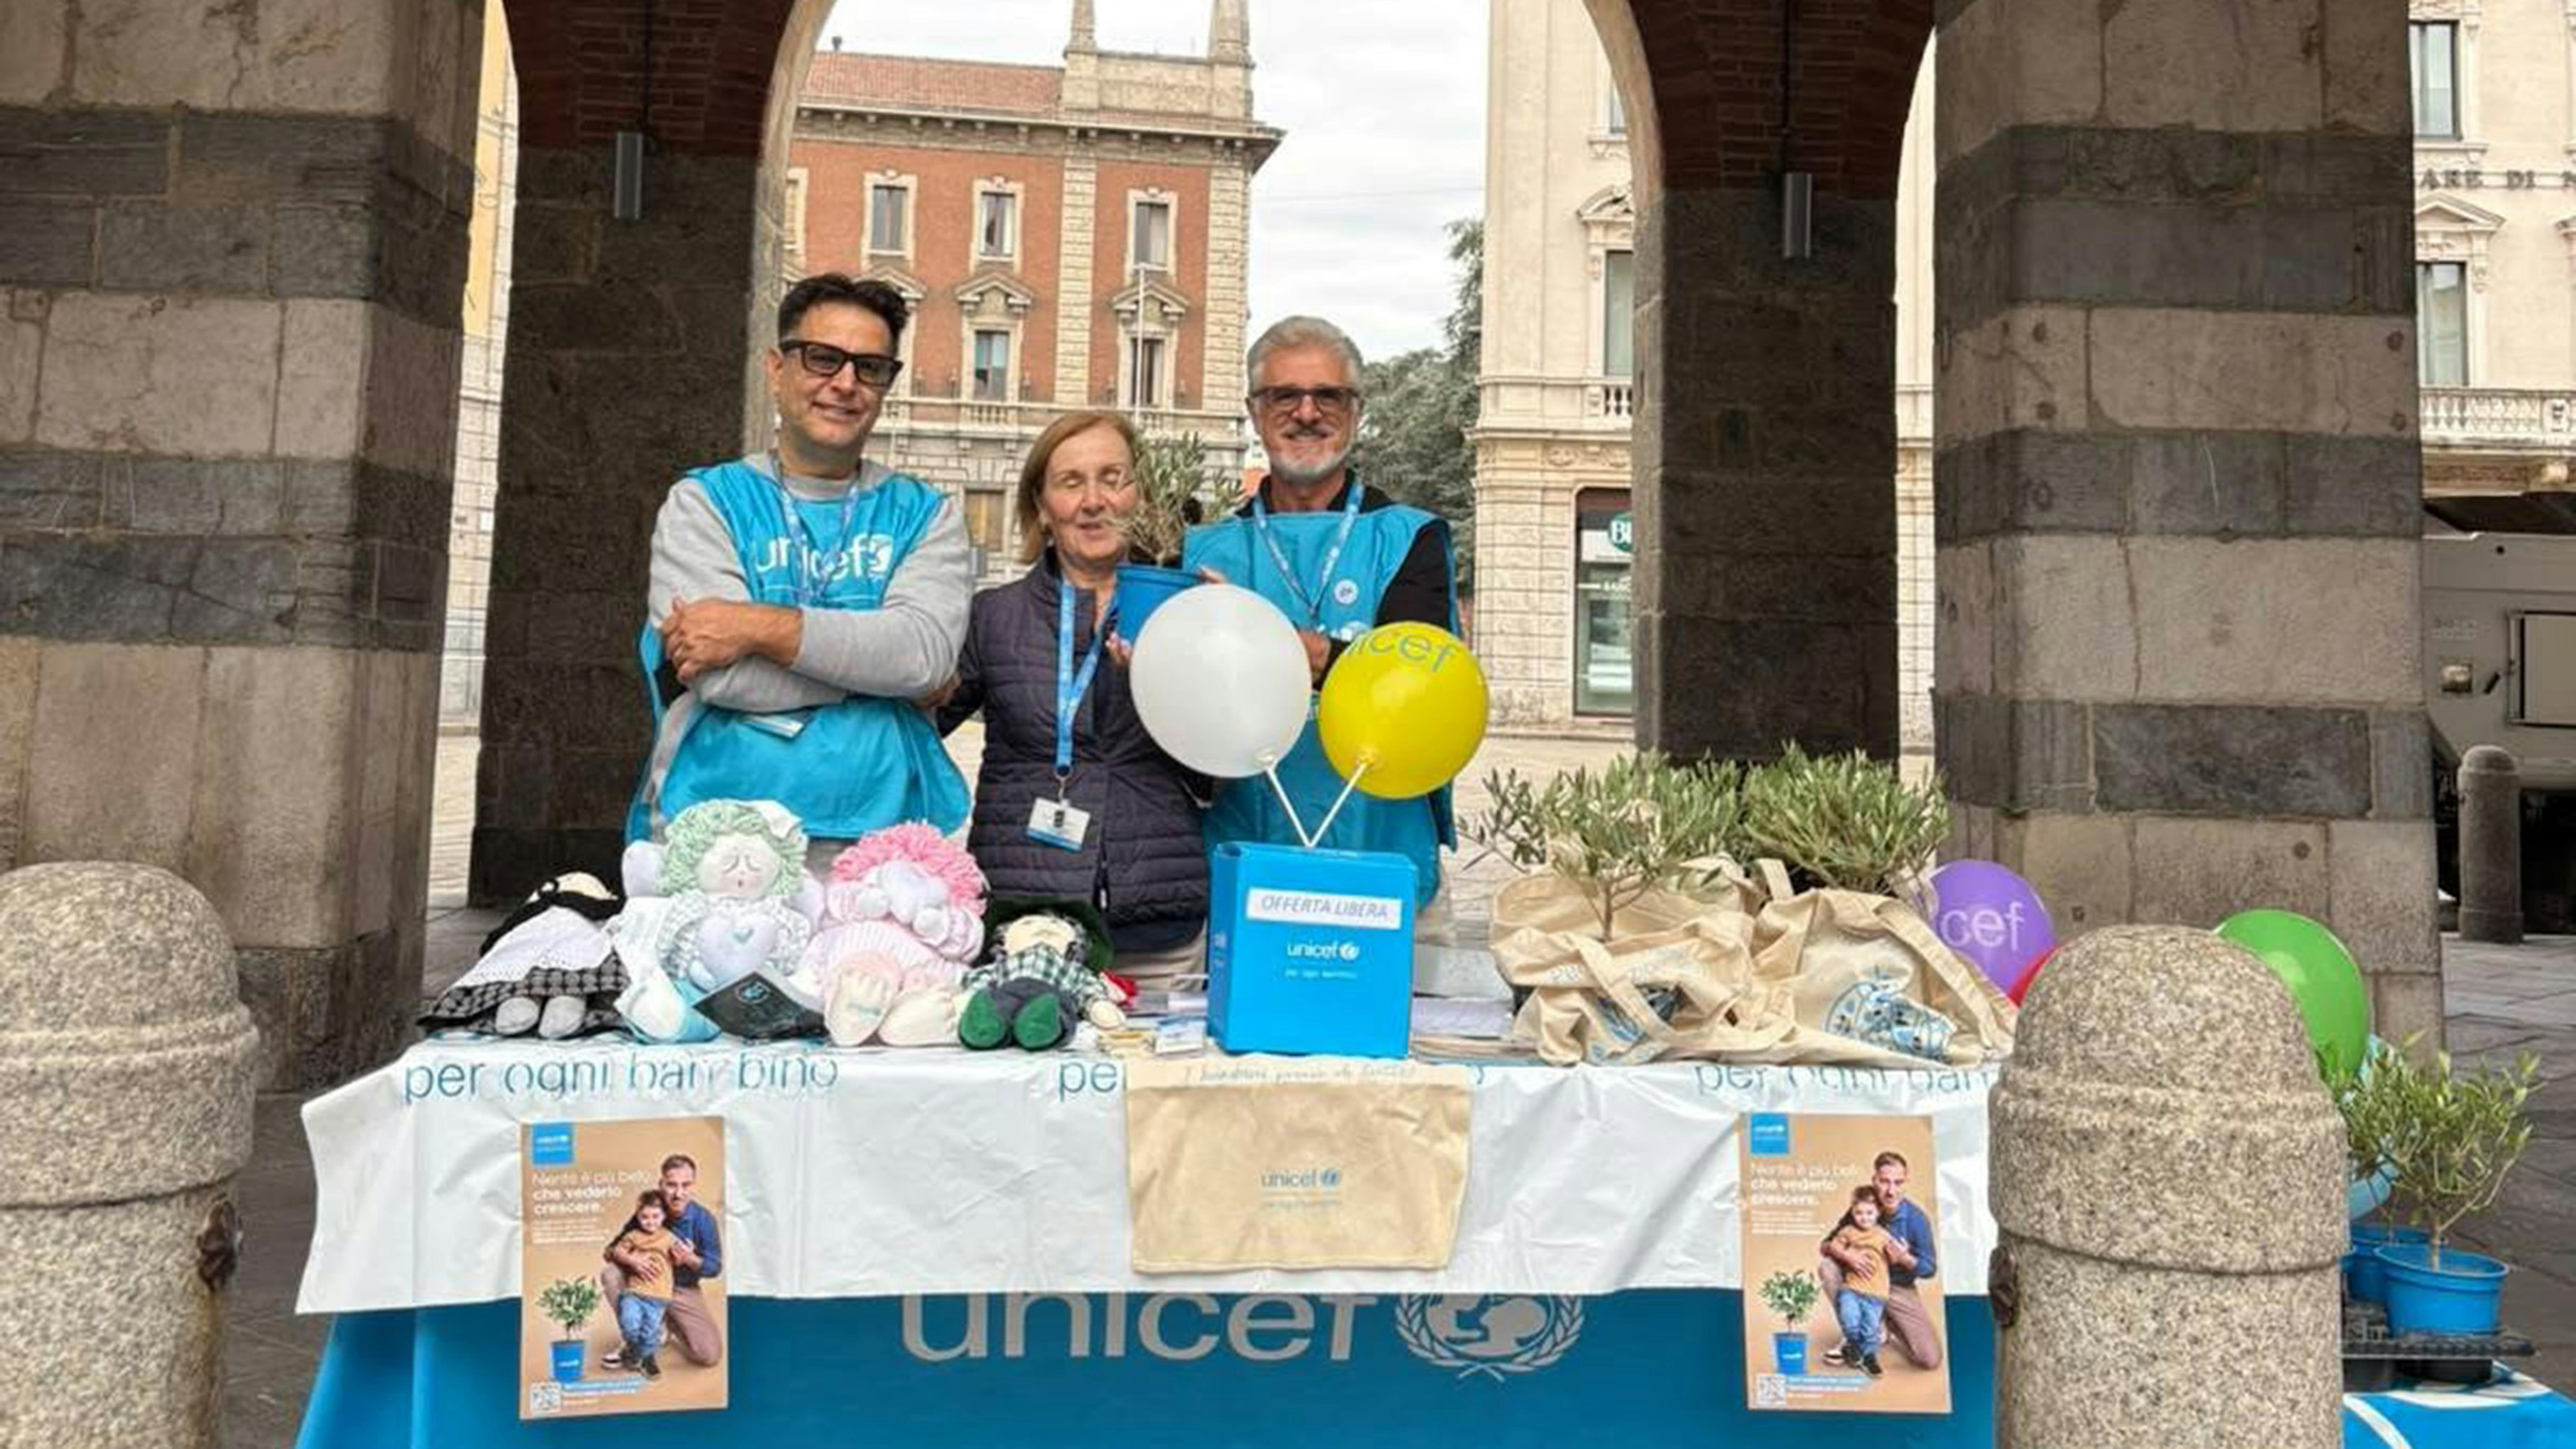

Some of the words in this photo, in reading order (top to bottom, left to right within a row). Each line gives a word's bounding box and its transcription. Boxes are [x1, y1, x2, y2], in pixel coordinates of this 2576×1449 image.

[2506, 169, 2535, 190] DI
[1261, 895, 1331, 914] OFFERTA
[1334, 901, 1388, 919] LIBERA
[1939, 901, 2025, 952] cef
[1287, 940, 1337, 961] unicef
[404, 1062, 485, 1104] per
[898, 1294, 1377, 1362] unicef
